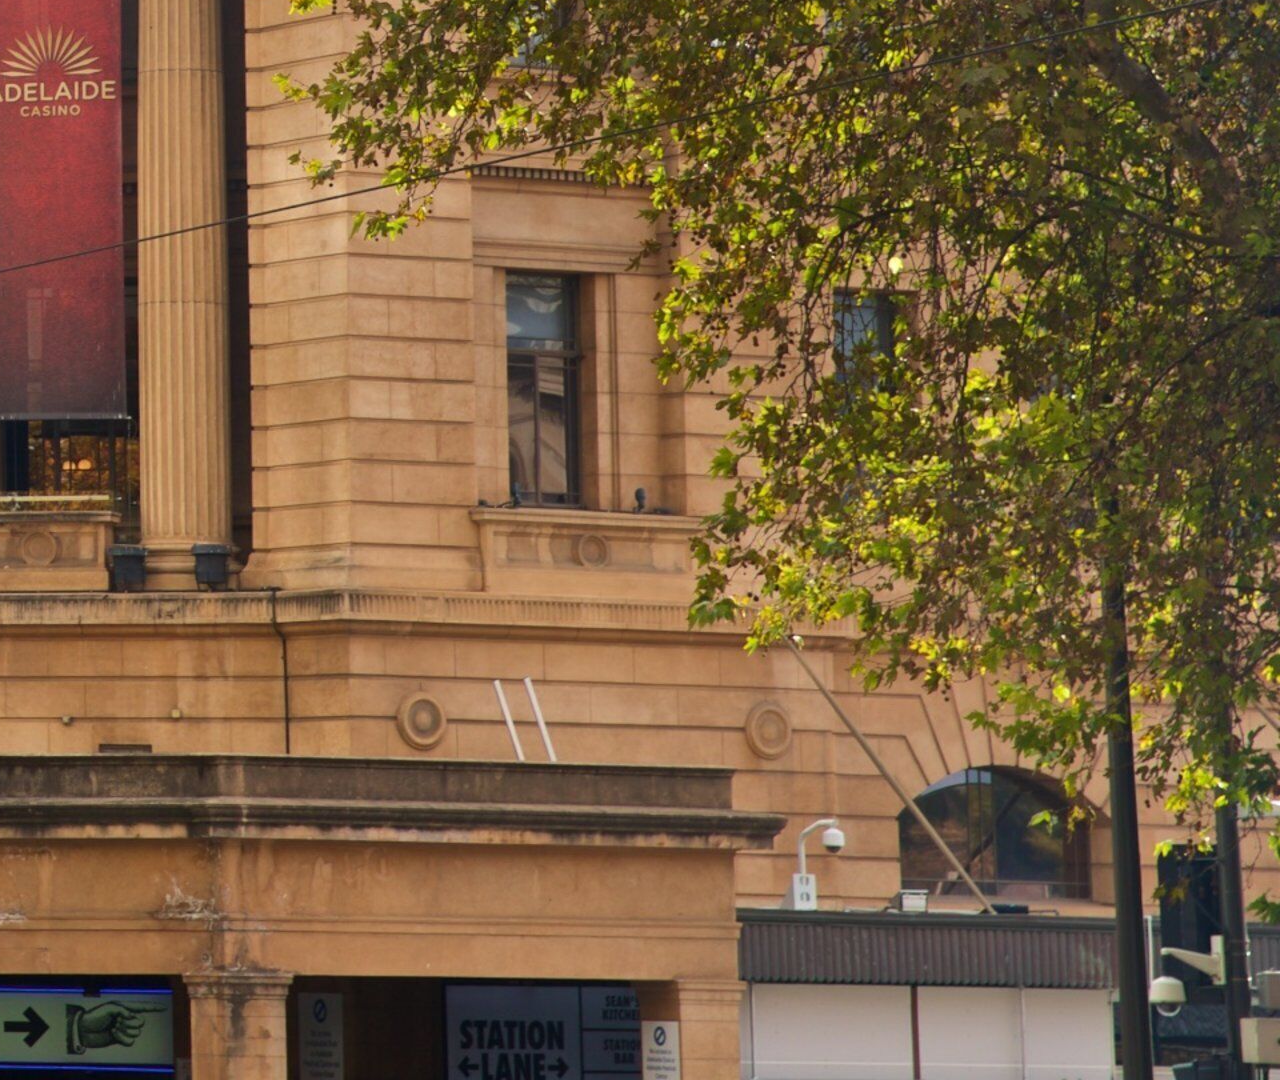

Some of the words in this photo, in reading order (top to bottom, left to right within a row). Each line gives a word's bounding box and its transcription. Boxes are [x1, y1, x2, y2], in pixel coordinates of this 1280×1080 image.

[20, 104, 81, 117] CASINO
[602, 1008, 640, 1021] KITCHE
[459, 1020, 565, 1050] STATION
[613, 1052, 635, 1064] BAR
[481, 1053, 547, 1080] LANE
